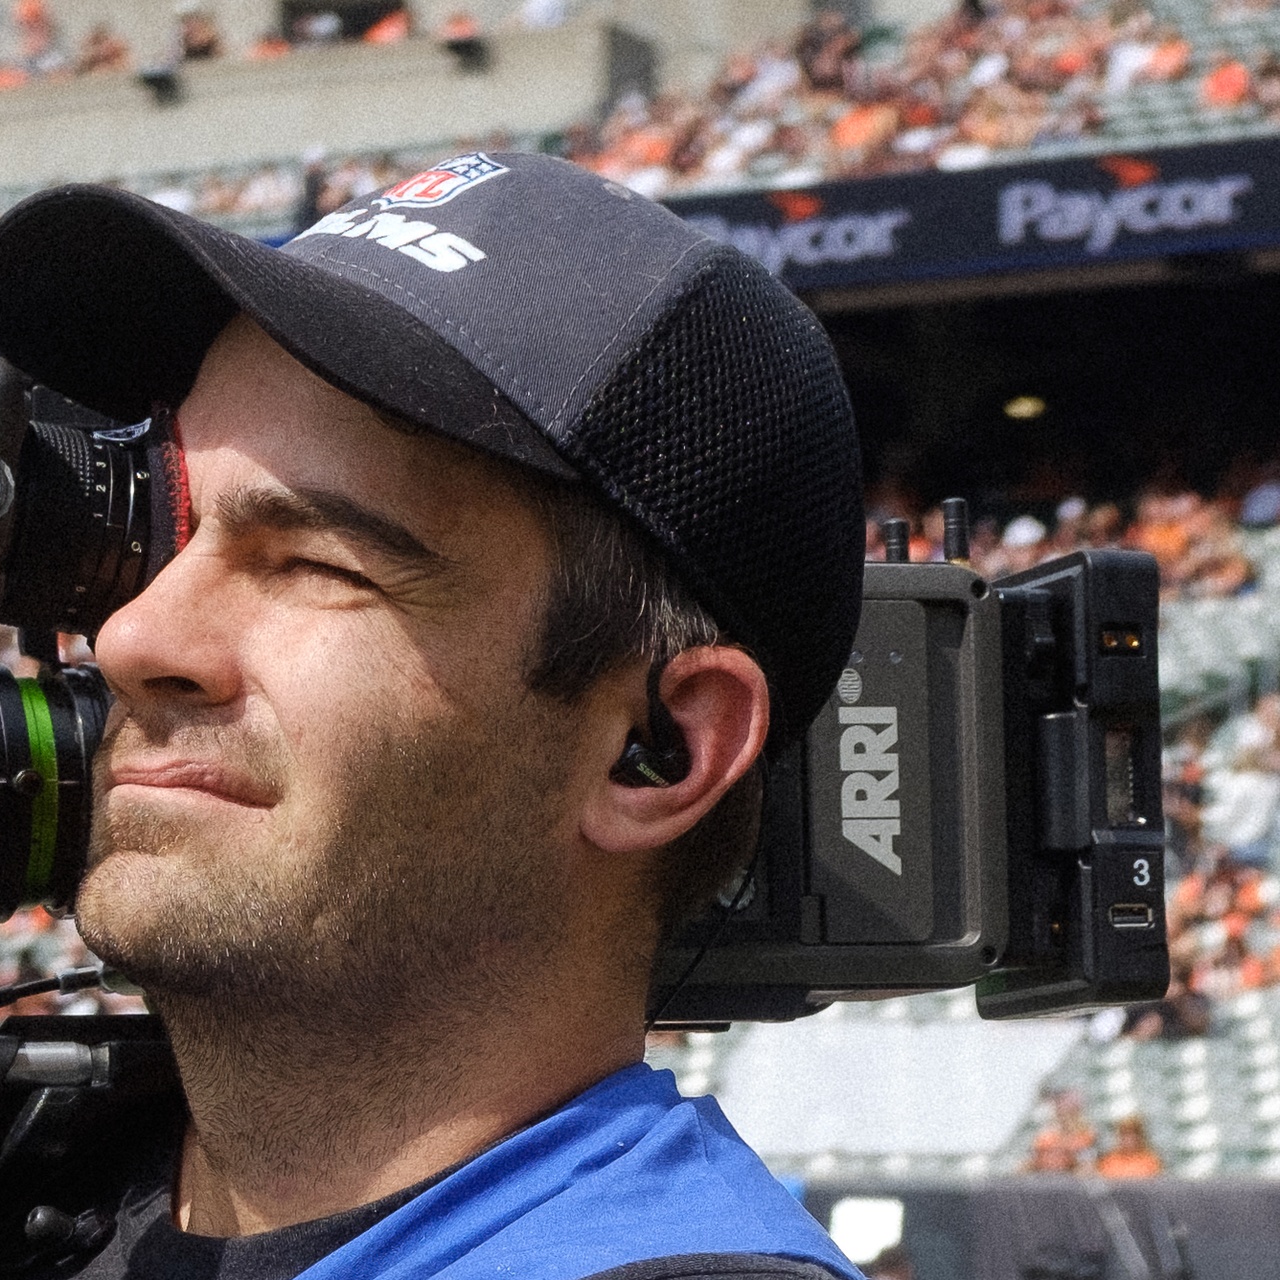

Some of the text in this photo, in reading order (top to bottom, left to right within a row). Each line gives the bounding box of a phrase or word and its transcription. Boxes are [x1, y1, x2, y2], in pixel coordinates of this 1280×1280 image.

[996, 176, 1252, 253] Paycor
[839, 706, 903, 877] ARRI
[1133, 858, 1151, 886] 3
